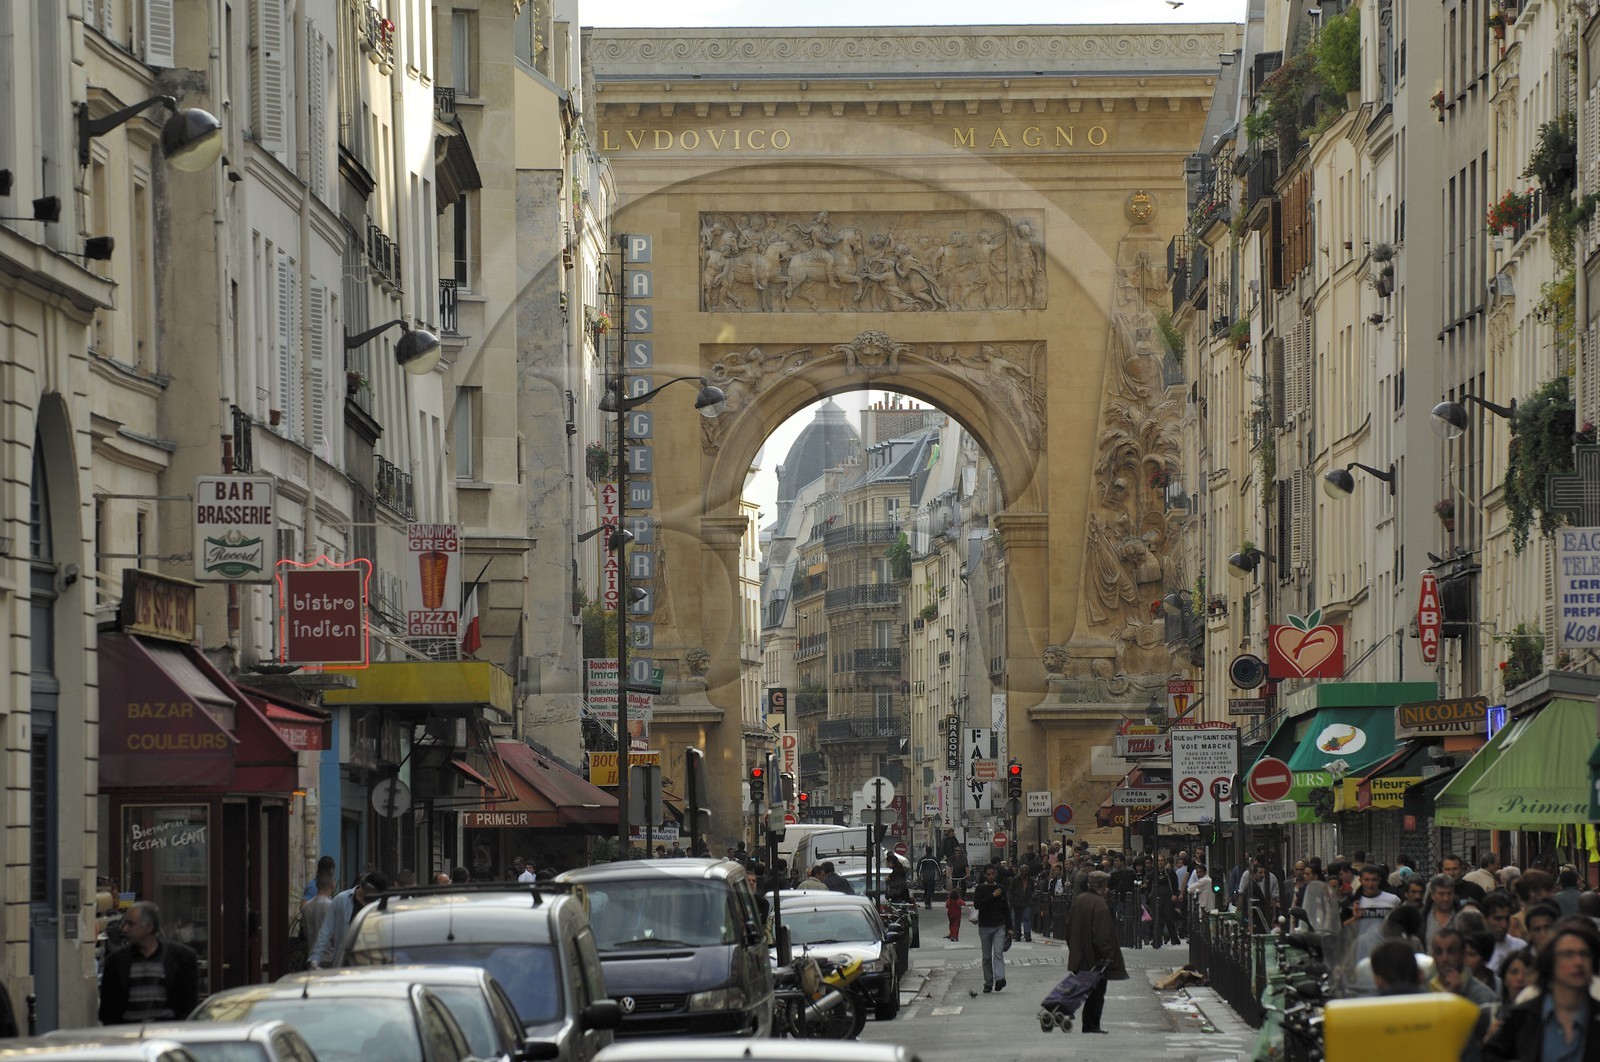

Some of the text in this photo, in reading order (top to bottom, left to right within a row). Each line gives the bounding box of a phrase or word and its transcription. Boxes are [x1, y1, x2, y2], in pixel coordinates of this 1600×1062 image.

[602, 125, 1109, 152] LVDOVICO MAGNO
[631, 237, 650, 470] PASSAGE
[216, 482, 253, 500] BAR
[632, 488, 650, 504] DU
[197, 505, 272, 525] BRASSERIE
[410, 525, 457, 539] SANDWICH
[409, 540, 456, 551] GREC
[206, 547, 260, 563] Record
[293, 592, 355, 611] bistro
[410, 612, 456, 624] PIZZA
[1420, 578, 1438, 659] TABAC
[293, 618, 356, 638] indien
[410, 623, 456, 635] GRILL
[589, 660, 619, 669] Boucheri
[127, 703, 194, 718] BAZAR
[1403, 700, 1487, 724] NICOLAS
[127, 734, 228, 750] COULEURS
[1127, 739, 1155, 753] PIZZAS
[1372, 779, 1411, 789] Fleurs
[1262, 804, 1286, 812] INTERDIT
[1267, 811, 1296, 819] CYCLISTES
[476, 813, 528, 826] PRIMEUR
[631, 833, 678, 841] PAKISANAISES
